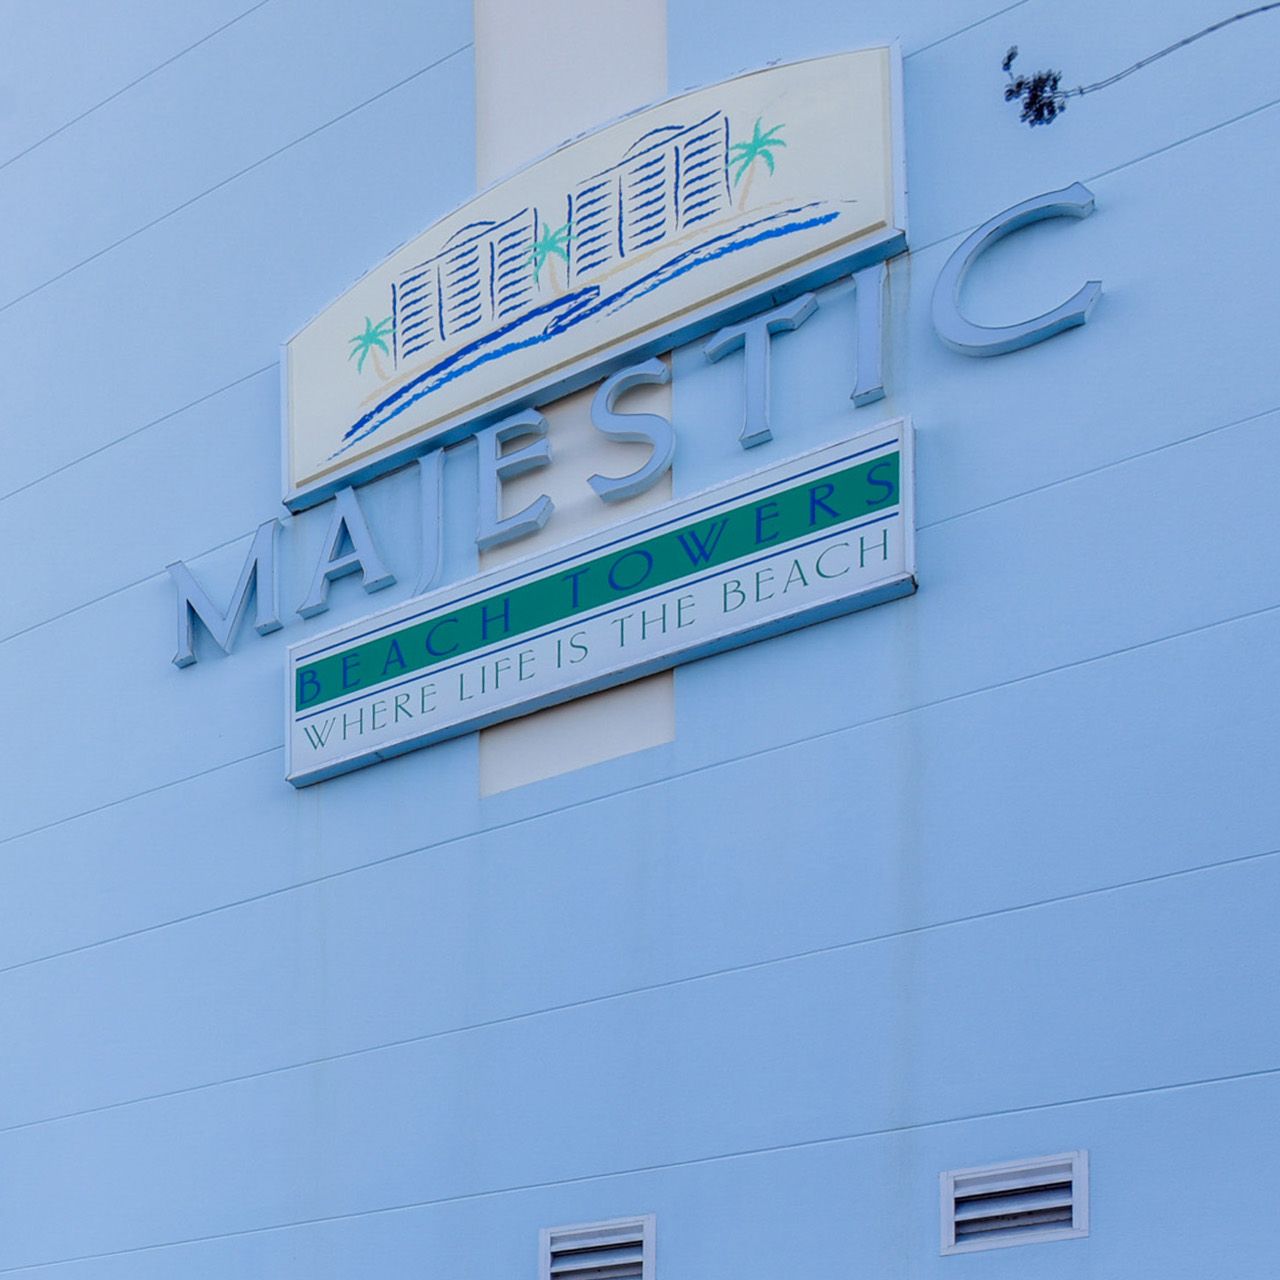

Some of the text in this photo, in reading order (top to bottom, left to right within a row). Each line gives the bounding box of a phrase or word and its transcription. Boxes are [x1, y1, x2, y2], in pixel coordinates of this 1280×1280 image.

[166, 181, 1102, 669] MAJESTIC
[298, 461, 895, 705] BEACH TOWERS
[303, 528, 888, 751] WHERE LIFE IS THE BEACH
